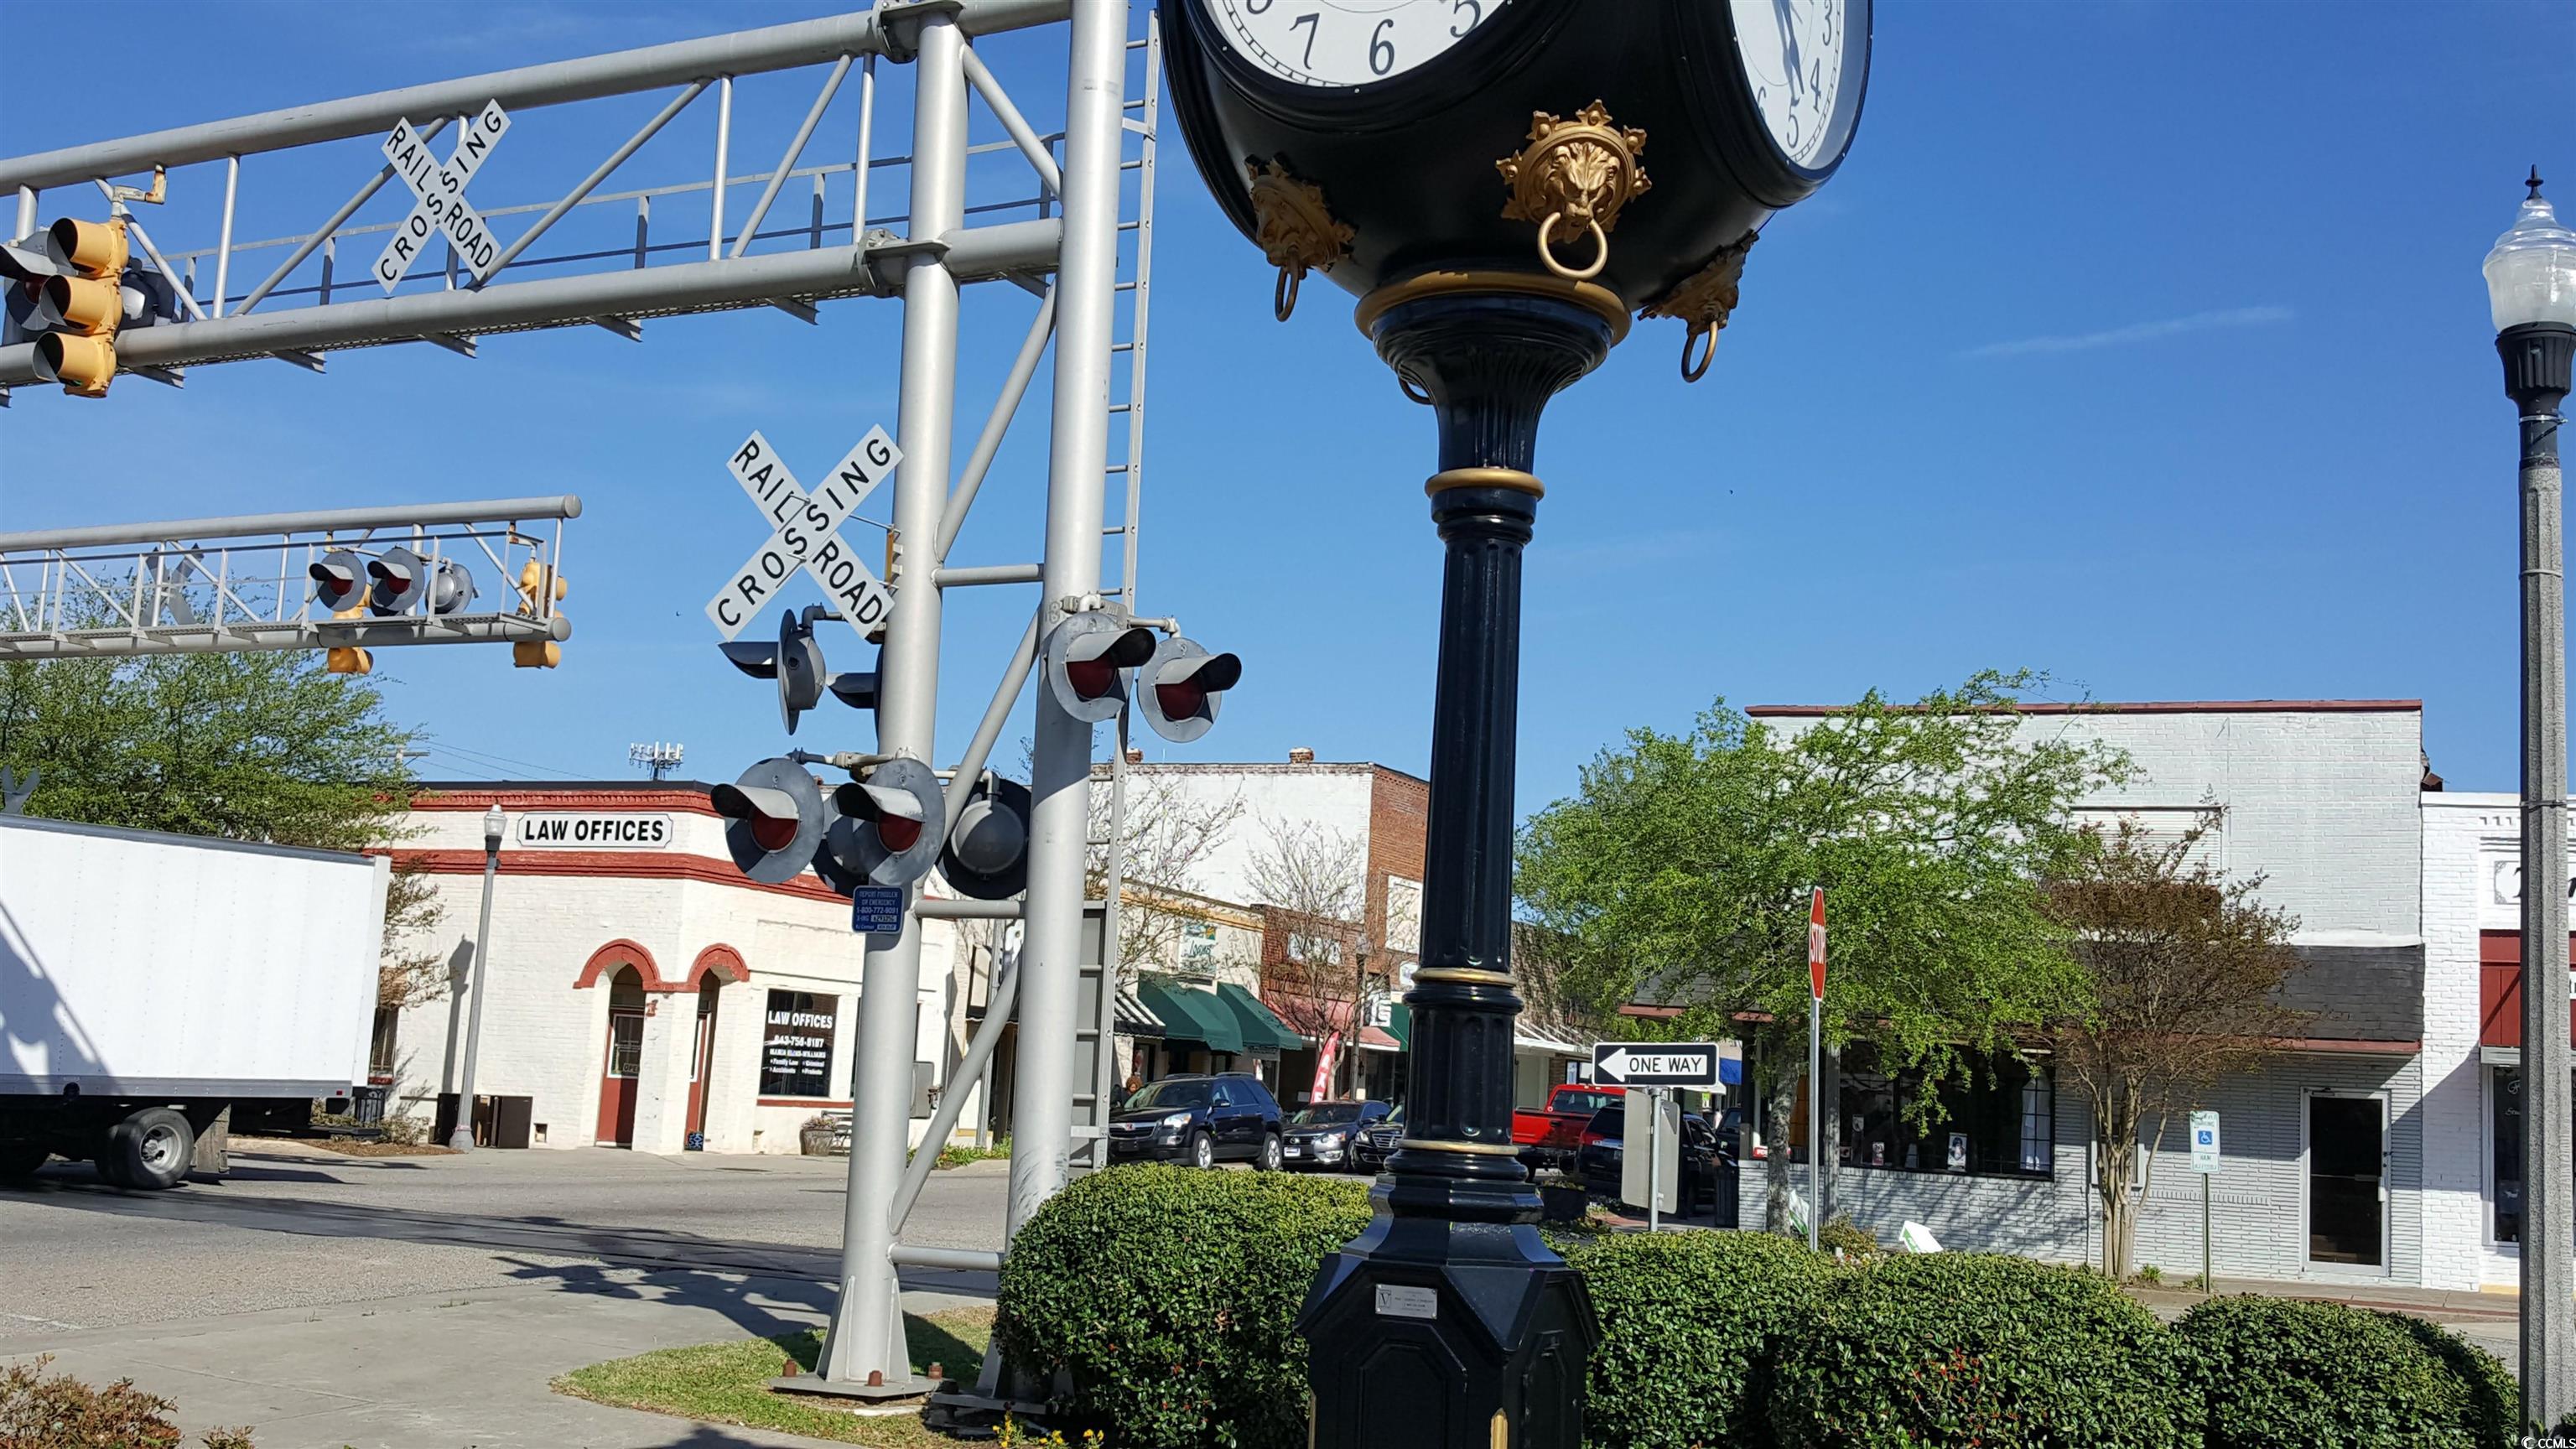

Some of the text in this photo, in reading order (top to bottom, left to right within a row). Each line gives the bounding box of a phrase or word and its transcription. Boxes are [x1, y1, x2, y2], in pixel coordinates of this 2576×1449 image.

[1289, 13, 1320, 70] 7
[1369, 18, 1394, 75] 6
[1810, 58, 1821, 113] 4
[381, 111, 501, 281] CROSSING
[718, 439, 891, 626] CROSSING
[525, 820, 664, 842] LAW OFFICES
[1811, 922, 1826, 964] STOP
[768, 1010, 833, 1029] LAW OFFICES
[1629, 1057, 1701, 1072] ONE WAY
